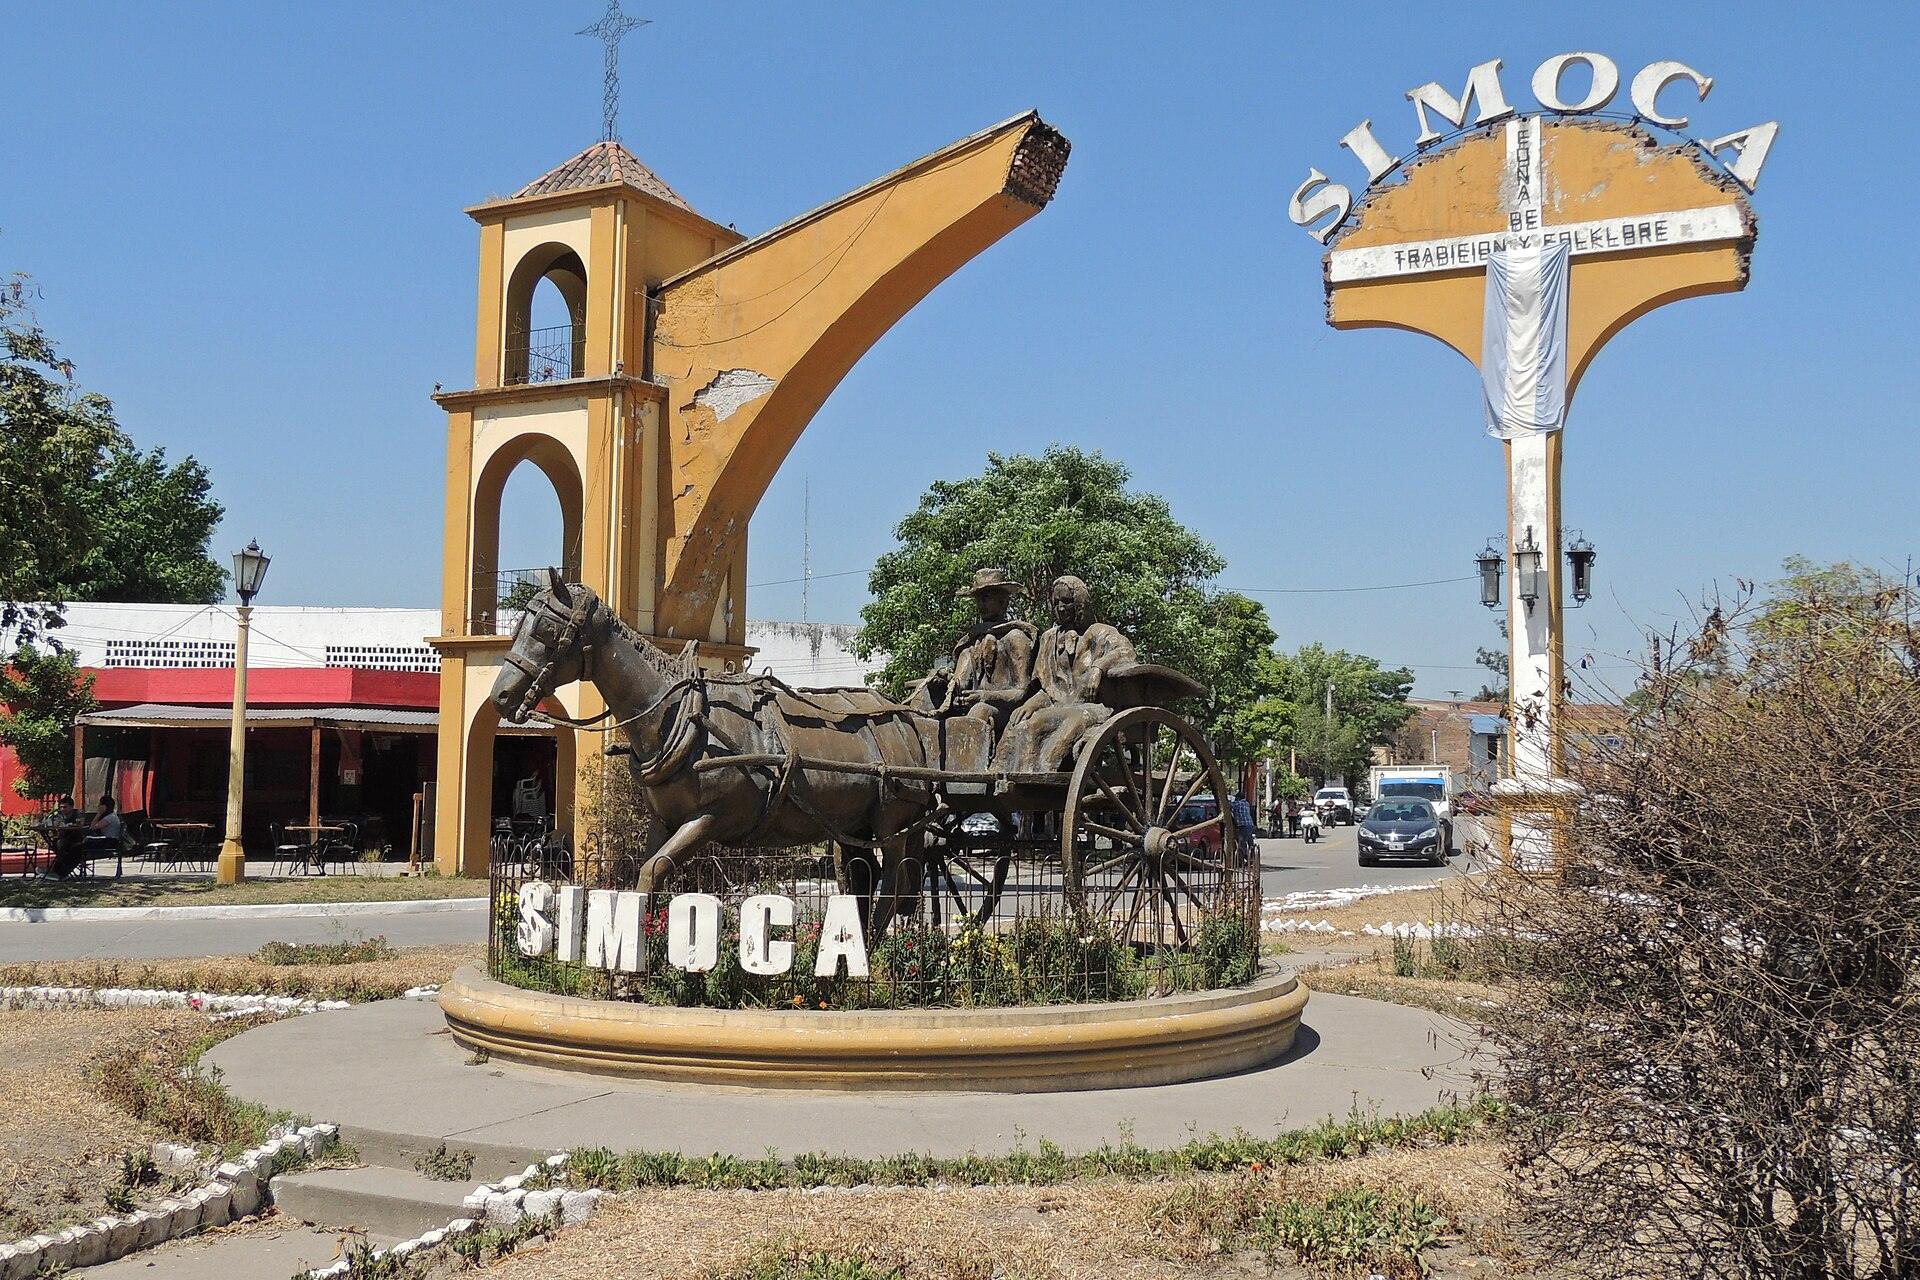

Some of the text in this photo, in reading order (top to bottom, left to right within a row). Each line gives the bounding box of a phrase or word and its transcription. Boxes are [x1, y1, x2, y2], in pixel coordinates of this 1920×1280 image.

[1288, 51, 1778, 245] SIMOCA
[1519, 236, 1531, 248] Y
[517, 882, 870, 977] SIMOCA
